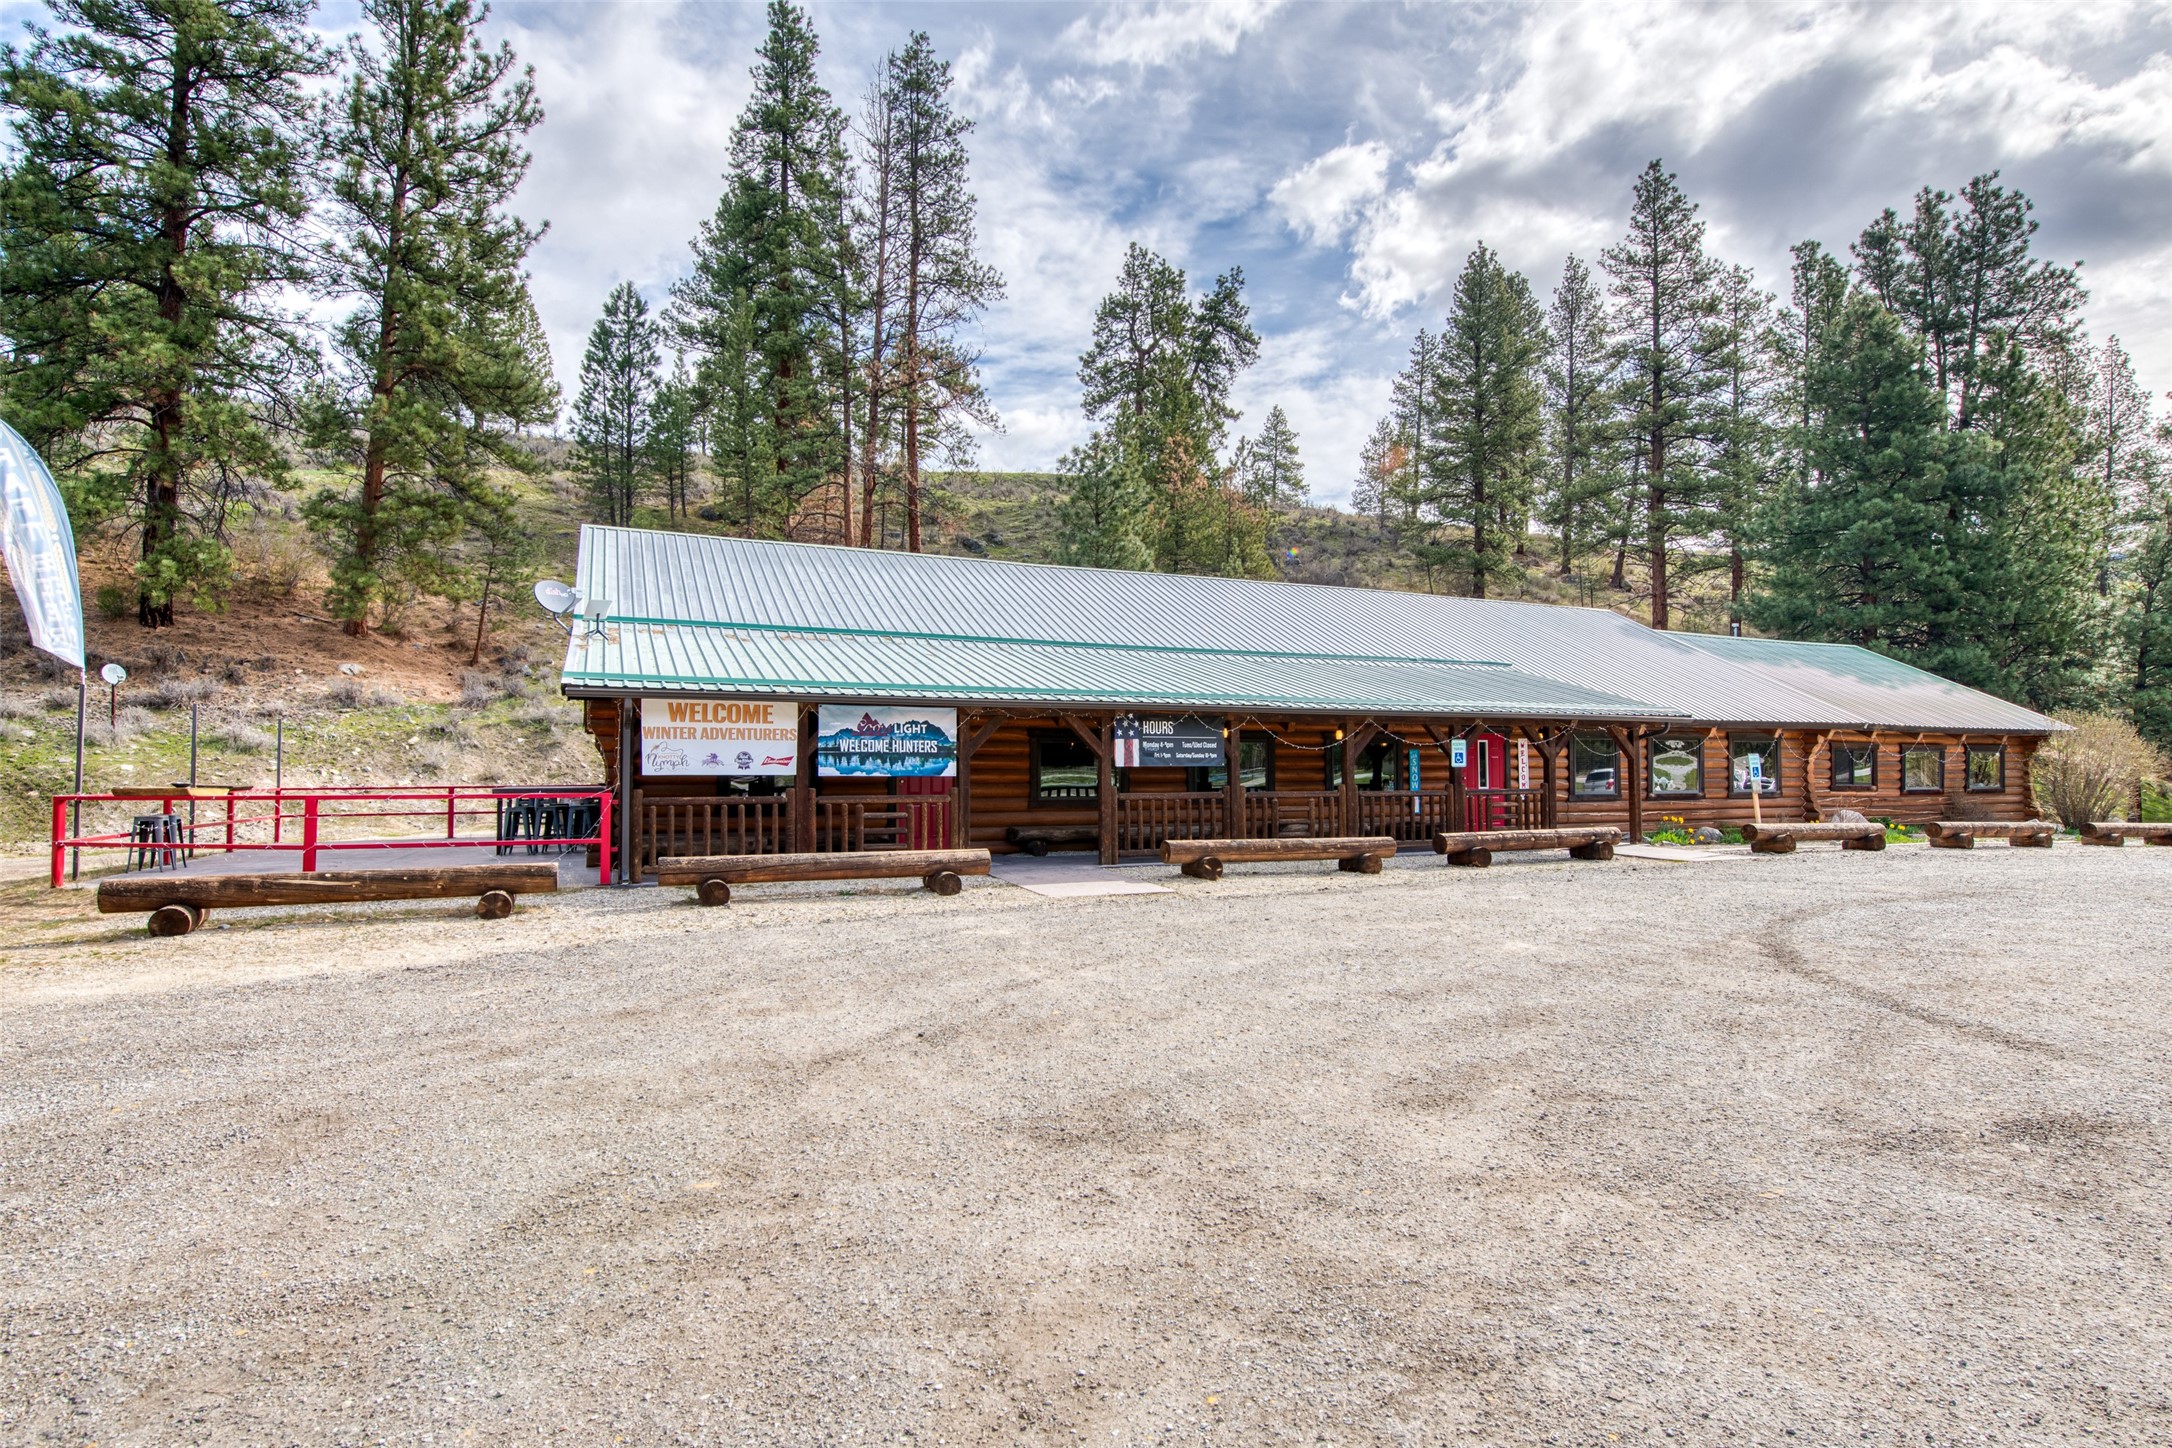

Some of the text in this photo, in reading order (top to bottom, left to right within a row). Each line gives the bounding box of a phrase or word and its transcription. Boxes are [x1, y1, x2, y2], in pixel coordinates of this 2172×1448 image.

[667, 702, 774, 724] WELCOME
[642, 726, 797, 742] WINTER ADVENTURERS
[894, 723, 928, 735] LIGHT
[1142, 720, 1174, 735] HOURS
[839, 739, 938, 754] WELCOME HUNTERS
